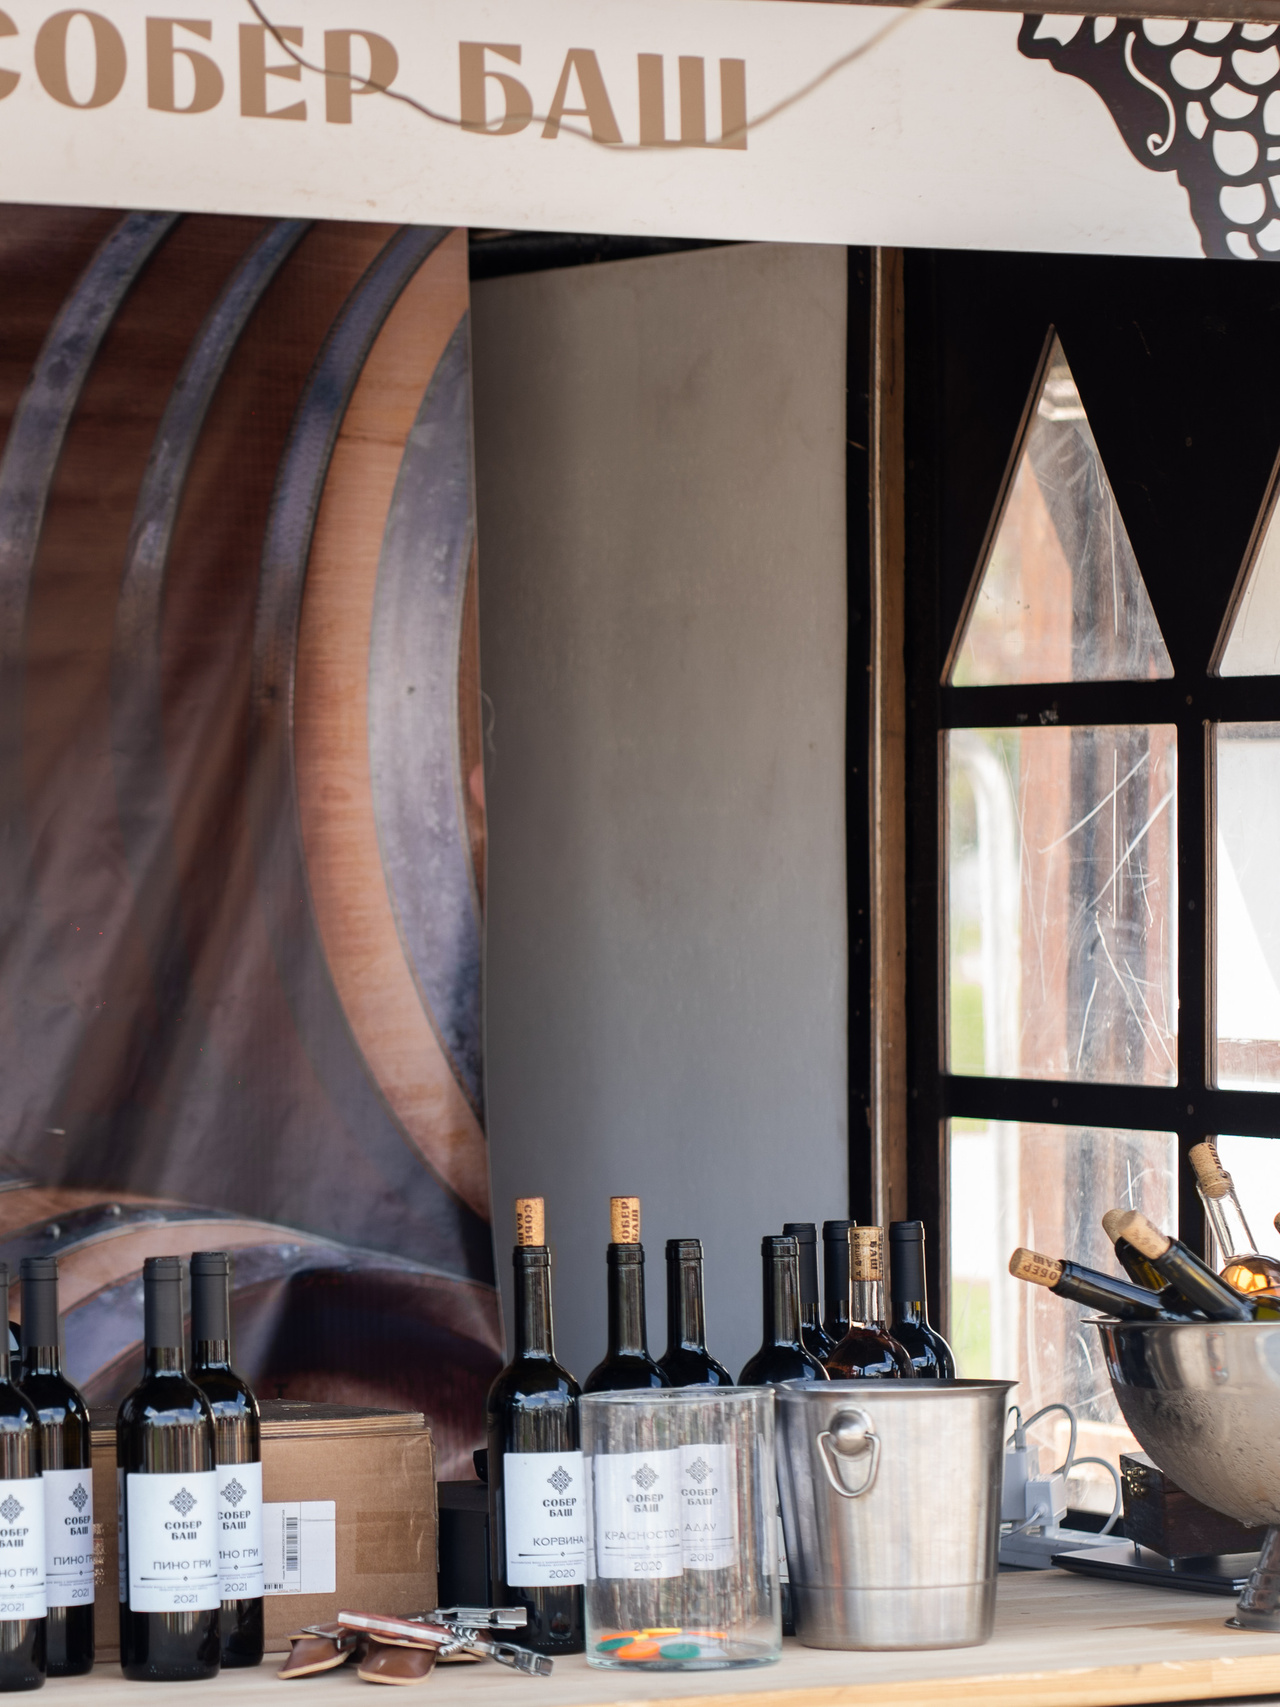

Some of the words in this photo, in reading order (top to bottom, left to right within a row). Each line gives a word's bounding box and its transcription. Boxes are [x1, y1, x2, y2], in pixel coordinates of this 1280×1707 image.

[457, 40, 748, 151] БАШ
[524, 1204, 534, 1246] СОБЕ
[621, 1201, 630, 1244] ОБЕР
[631, 1209, 639, 1242] БАШ
[516, 1212, 524, 1245] БАШ
[869, 1240, 878, 1270] БАШ
[1023, 1263, 1057, 1280] ОБЕР
[681, 1487, 718, 1497] СОБЕР
[542, 1497, 577, 1507] СОБЕР
[626, 1493, 664, 1504] СОБЕР
[687, 1497, 713, 1506] БАШ
[549, 1508, 573, 1517] БАШ
[633, 1504, 659, 1513] БАШ
[218, 1510, 251, 1520] СОБЕР
[64, 1515, 91, 1526] СОБЕР
[164, 1520, 202, 1530] СОБЕР
[222, 1521, 247, 1530] БАШ
[70, 1526, 89, 1536] БАШ
[684, 1522, 717, 1532] АДАУ
[171, 1531, 197, 1541] БАШ
[533, 1536, 584, 1547] КОРВИНА
[219, 1549, 240, 1560] ИНО
[242, 1548, 259, 1558] ГРИ
[690, 1552, 714, 1562] 2019
[53, 1555, 85, 1566] ПИНО
[85, 1554, 93, 1564] ГР
[153, 1560, 190, 1571] ПИНО
[193, 1559, 212, 1569] ГРИ
[633, 1561, 663, 1572] 2020
[20, 1567, 38, 1577] ГРИ
[548, 1568, 576, 1579] 2020
[224, 1582, 248, 1592] 2021
[71, 1588, 89, 1598] 2021
[173, 1594, 198, 1604] 2021
[0, 1603, 25, 1612] 2021
